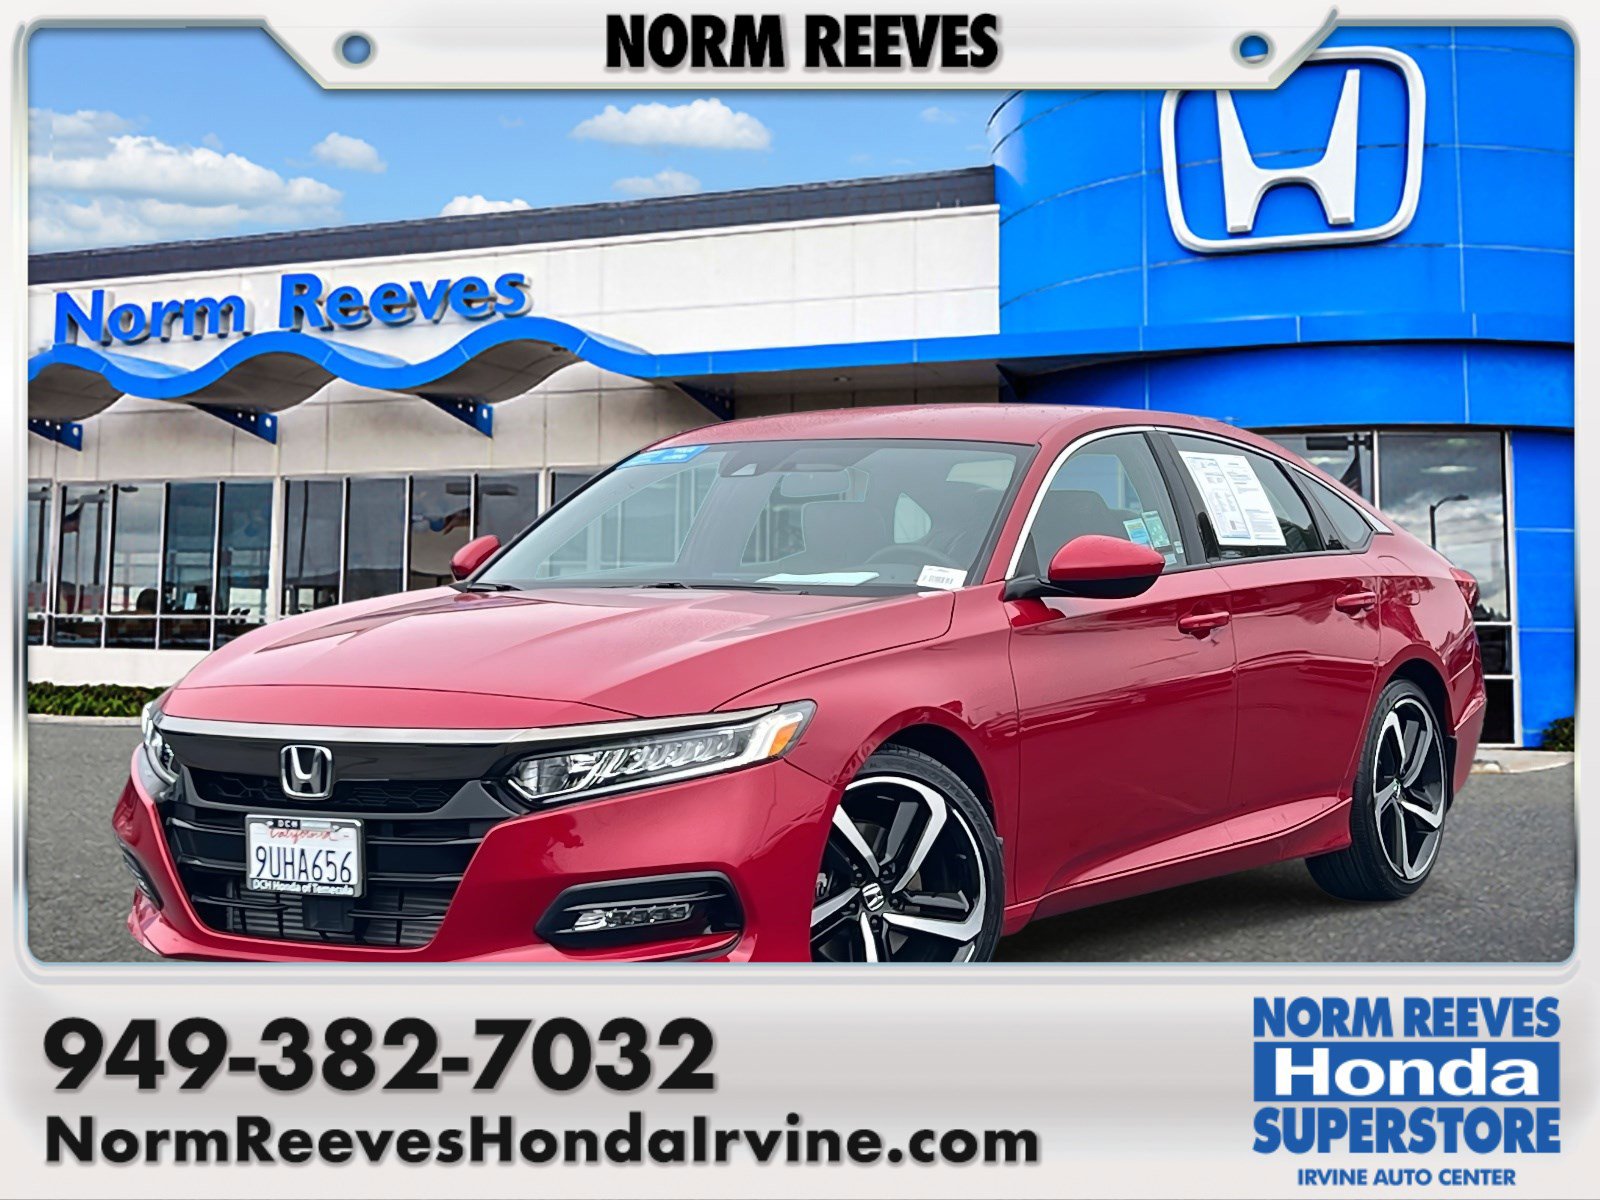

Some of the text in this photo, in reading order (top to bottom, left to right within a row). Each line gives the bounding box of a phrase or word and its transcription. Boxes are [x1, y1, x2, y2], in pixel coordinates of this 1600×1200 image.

[53, 271, 529, 344] Norm Reeves
[255, 845, 353, 883] 9UHA656
